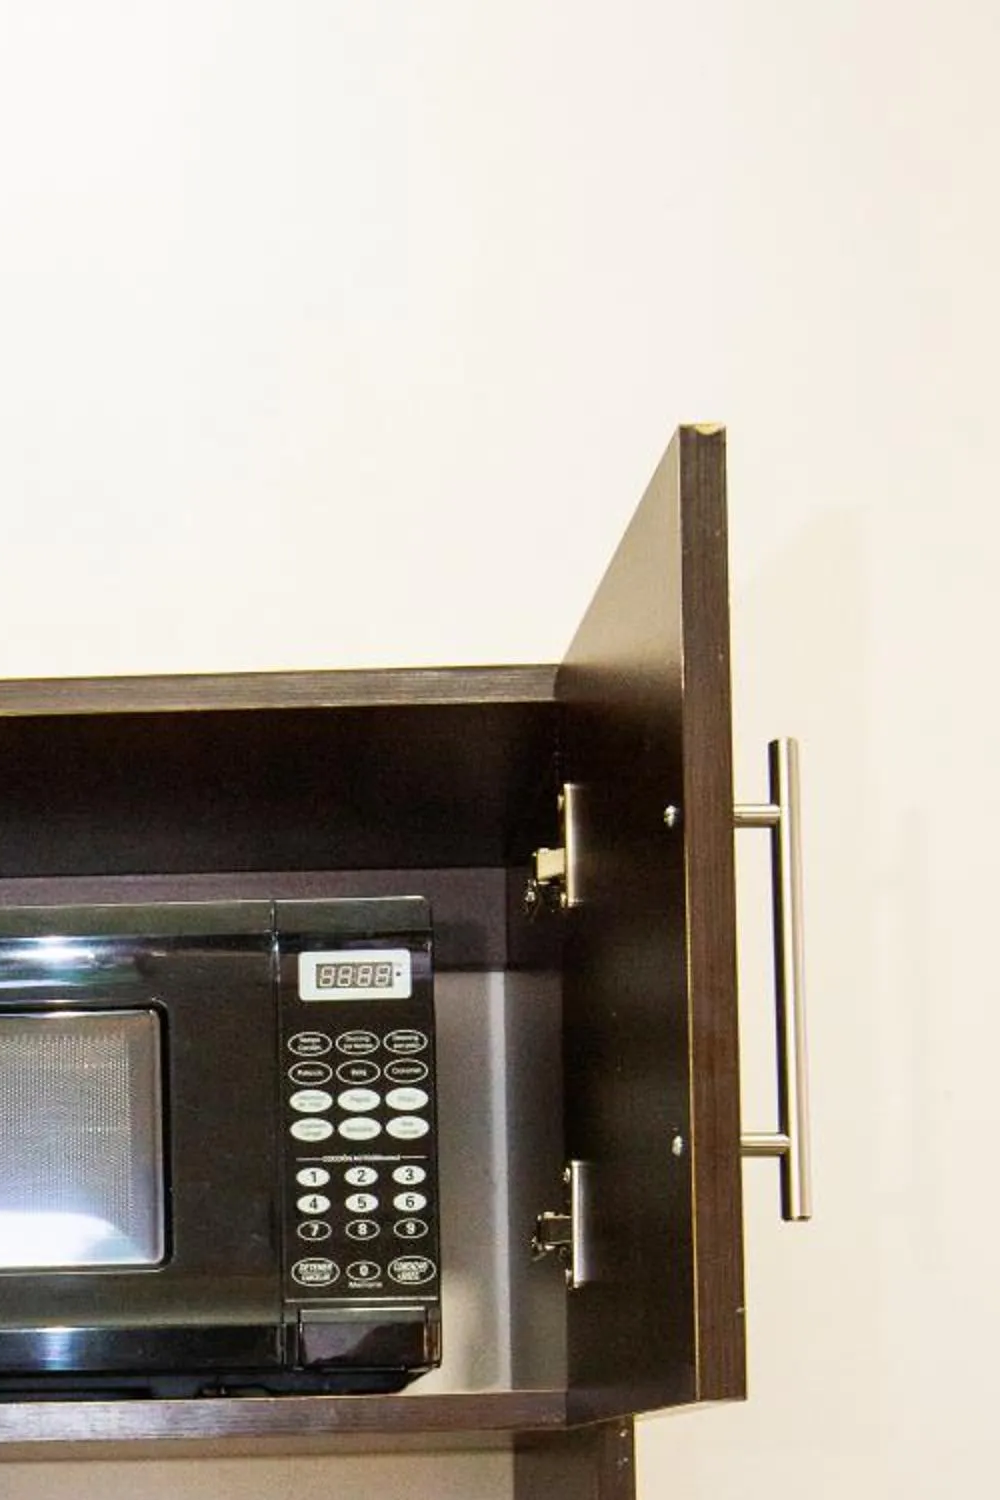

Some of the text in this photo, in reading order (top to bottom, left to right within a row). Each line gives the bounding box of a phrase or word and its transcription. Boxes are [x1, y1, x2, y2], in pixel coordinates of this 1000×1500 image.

[309, 1171, 318, 1183] 1
[357, 1169, 366, 1182] 2
[405, 1168, 414, 1181] 3
[309, 1197, 318, 1210] 4
[357, 1196, 366, 1209] 5
[405, 1195, 414, 1208] 6
[310, 1223, 319, 1236] 7
[358, 1223, 367, 1236] 8
[405, 1222, 415, 1235] 9
[359, 1265, 369, 1276] 0
